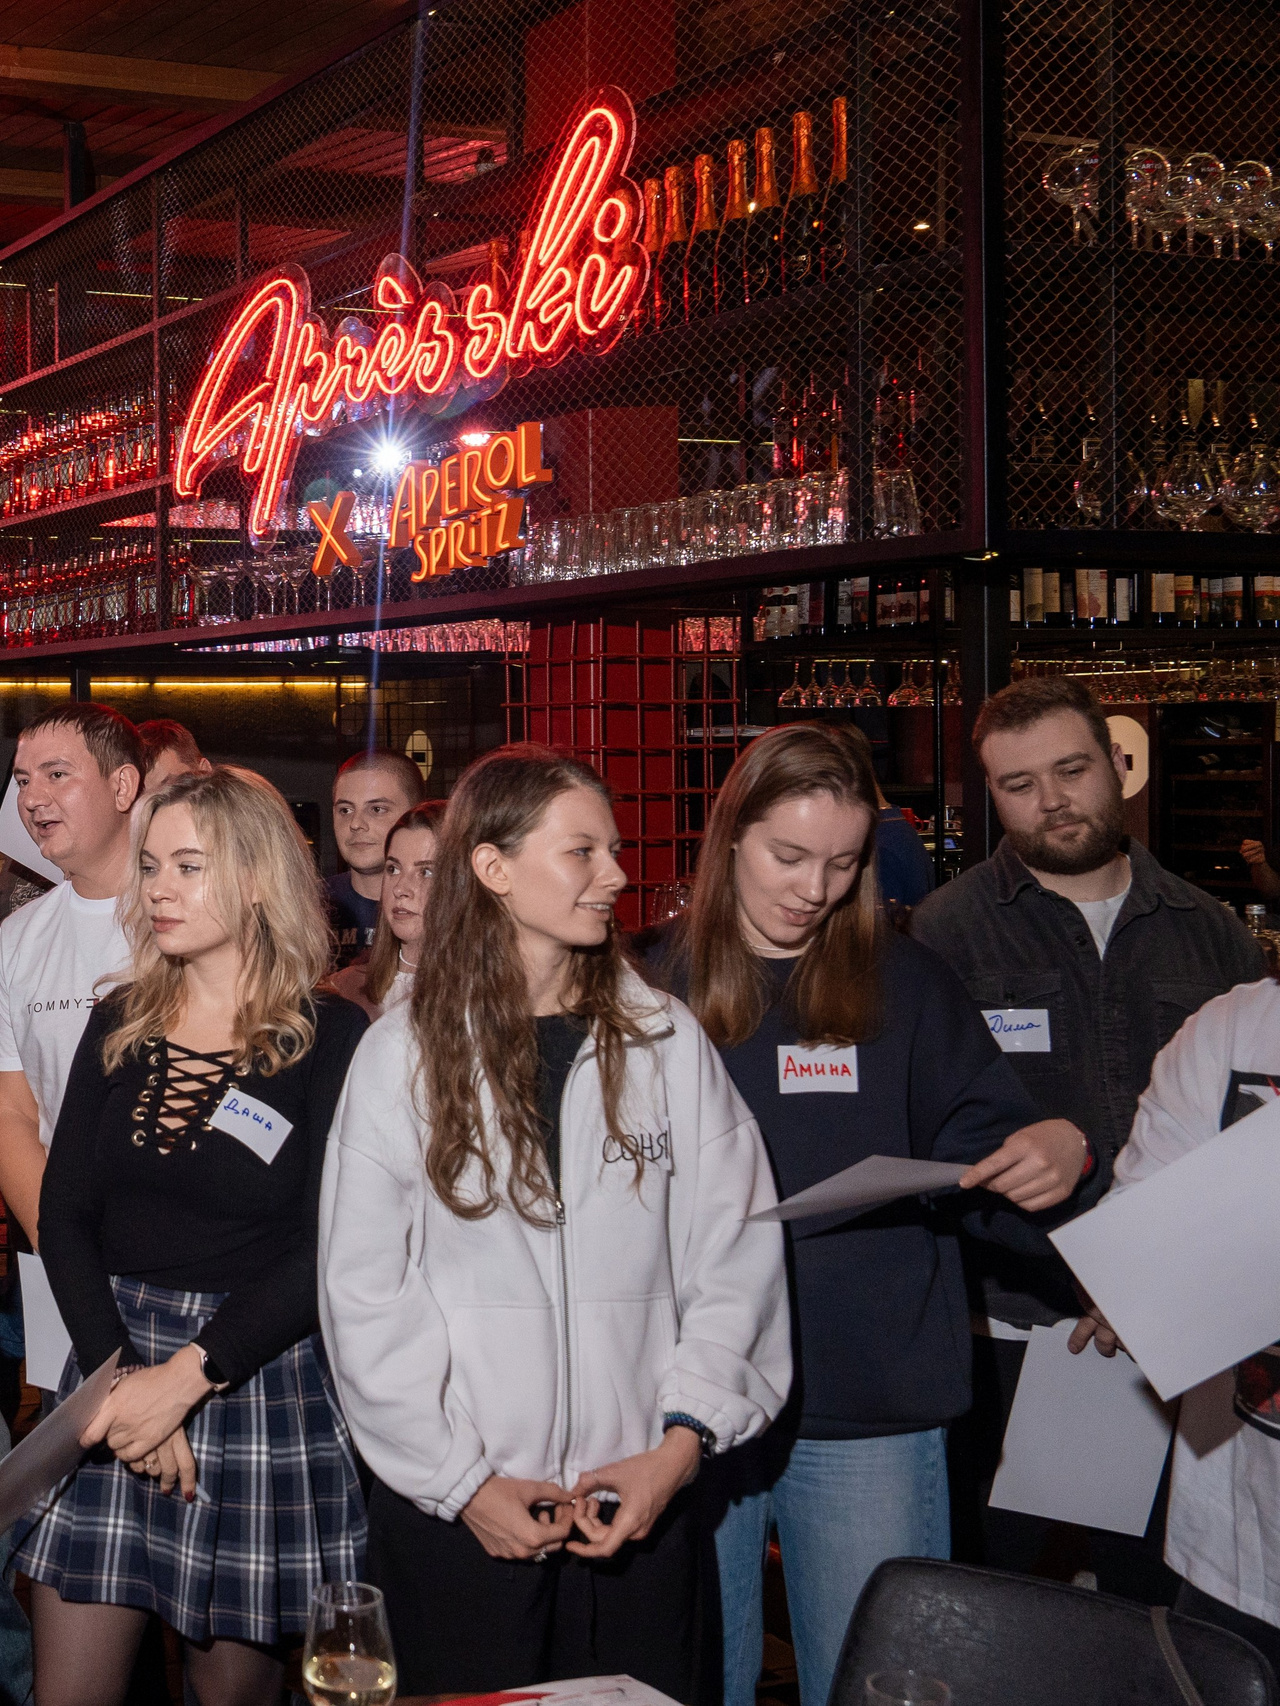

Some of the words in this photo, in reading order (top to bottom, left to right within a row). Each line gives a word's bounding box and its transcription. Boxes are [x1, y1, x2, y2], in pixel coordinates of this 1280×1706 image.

[175, 275, 455, 536] Après
[464, 107, 634, 379] ski
[389, 422, 542, 548] APEROL
[27, 998, 83, 1015] TOMMY
[602, 1129, 669, 1164] СОНЯ
